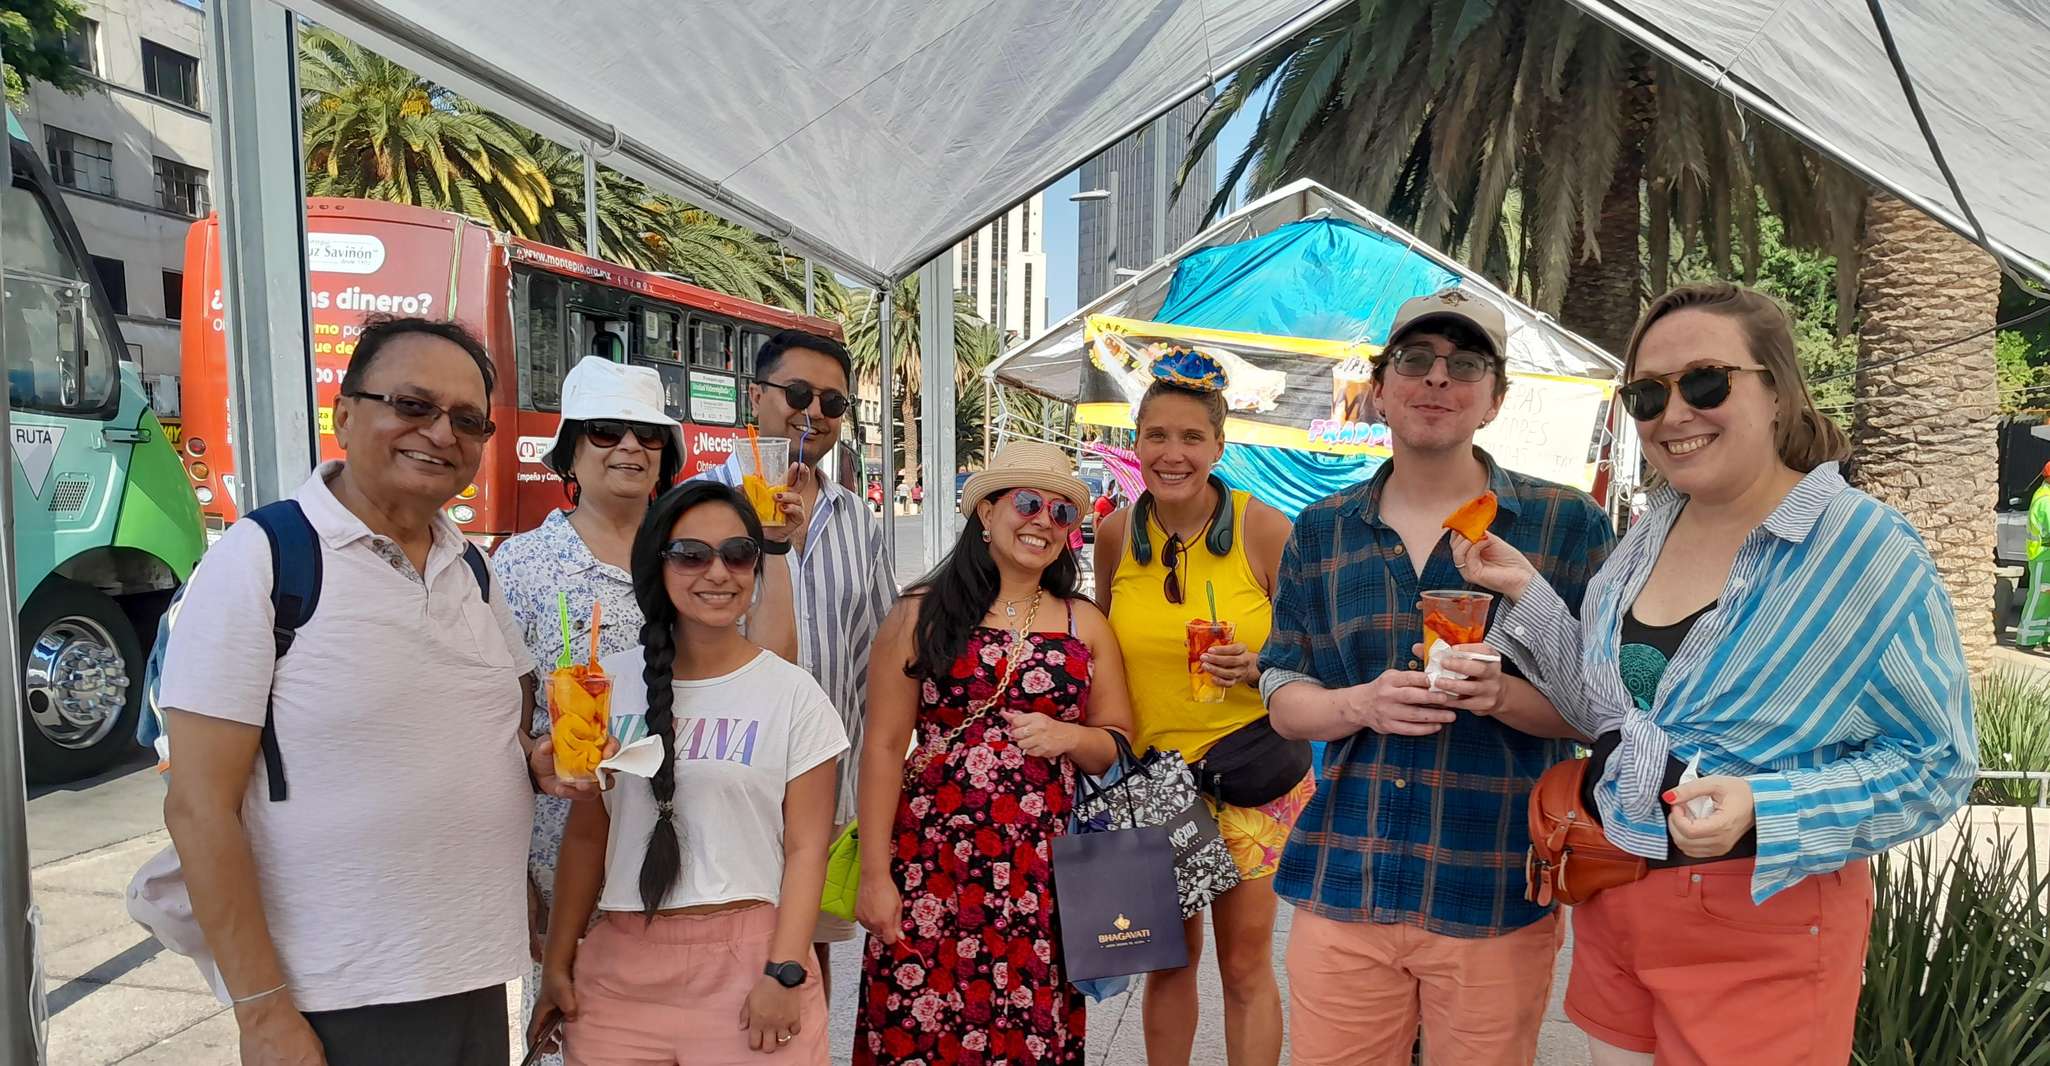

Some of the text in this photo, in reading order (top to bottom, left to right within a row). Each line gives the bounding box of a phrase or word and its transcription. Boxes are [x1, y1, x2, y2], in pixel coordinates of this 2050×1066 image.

[325, 245, 372, 260] Saviñón
[336, 287, 433, 314] dinero?
[16, 428, 53, 445] RUTA
[693, 432, 738, 455] ¿Necesi
[516, 472, 541, 483] Empeña
[541, 474, 546, 483] y
[1098, 929, 1151, 944] BHAGAVATI
